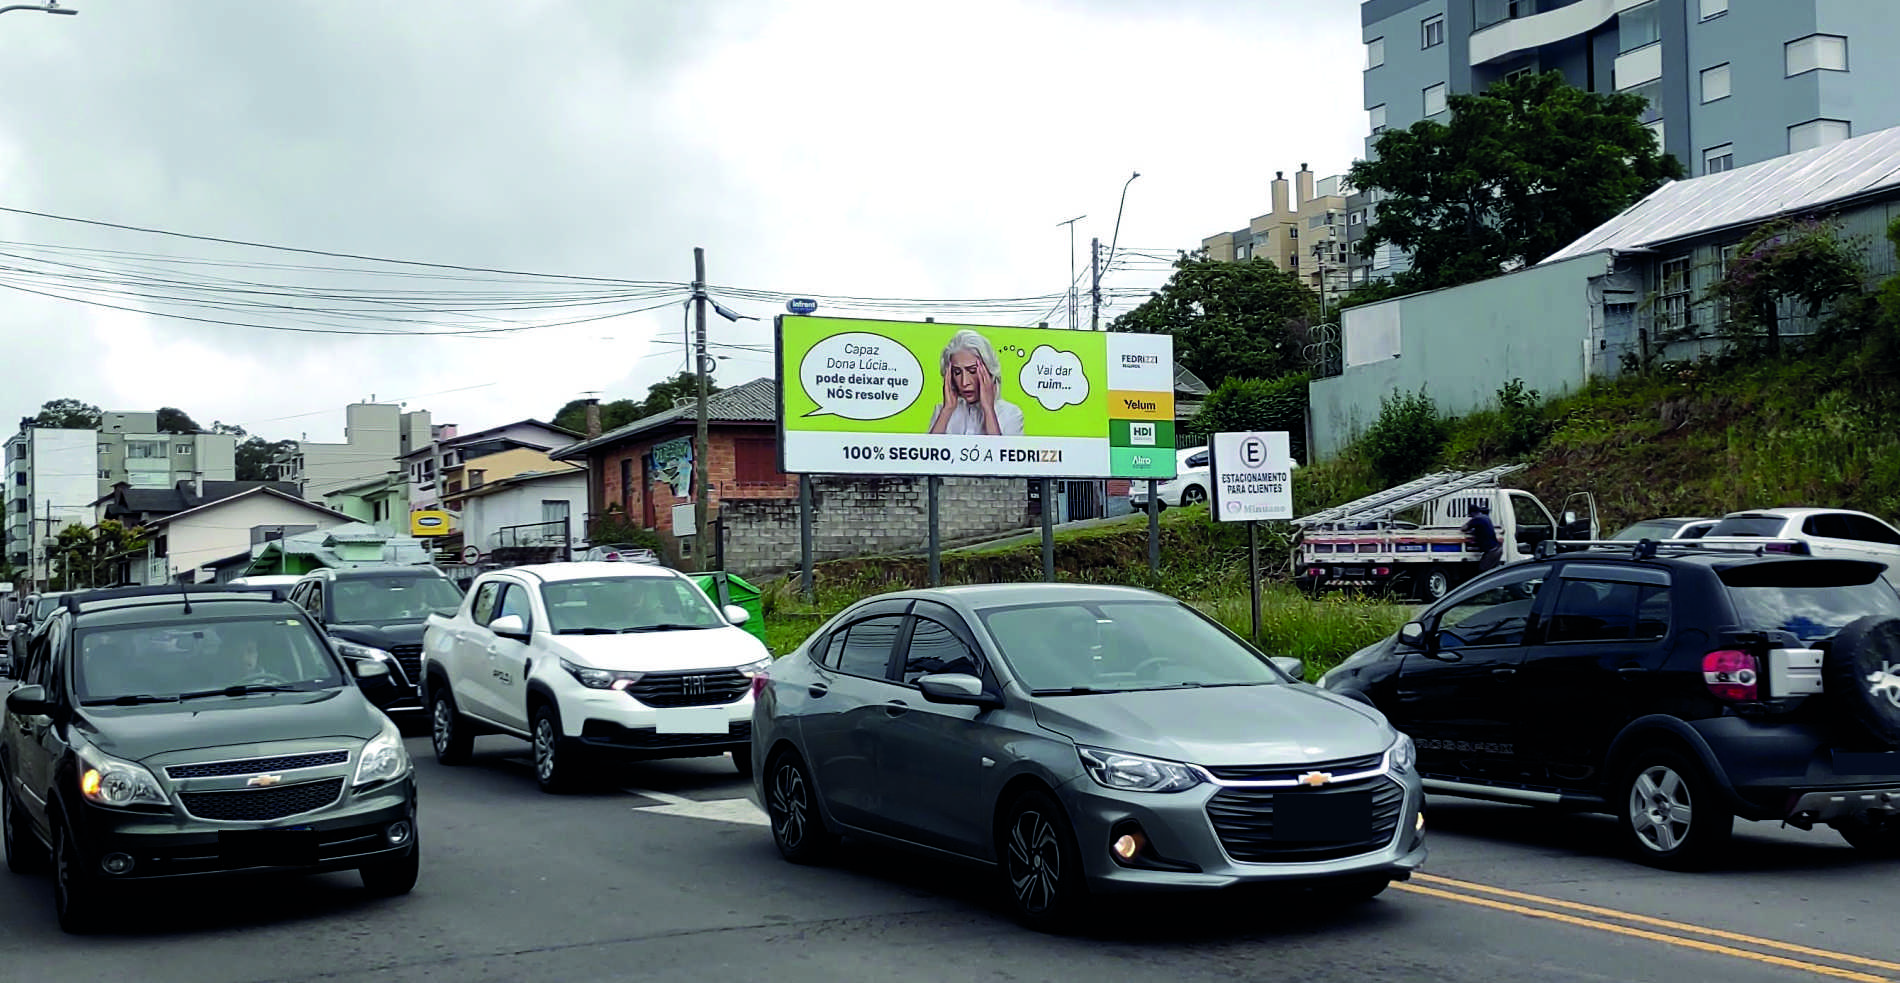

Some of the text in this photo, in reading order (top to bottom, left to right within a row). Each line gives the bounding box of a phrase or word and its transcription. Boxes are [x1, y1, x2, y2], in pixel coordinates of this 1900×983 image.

[844, 343, 879, 356] Capaz
[827, 357, 856, 369] Dona
[1121, 354, 1158, 364] FEDRIZZI
[1036, 364, 1073, 376] Vai dar
[816, 373, 909, 388] pode deixar que
[1037, 379, 1072, 390] ruim...
[827, 385, 899, 401] NÓS resolve
[1124, 399, 1156, 410] Yelum
[1133, 427, 1152, 436] HDI
[842, 444, 1062, 464] 100% SEGURO, SÓ A FEDRIZZI
[1247, 442, 1260, 462] E
[1222, 472, 1287, 483] ESTACIONAMENTO
[1227, 484, 1283, 494] PARA CLIENTES
[682, 675, 706, 695] FIAT
